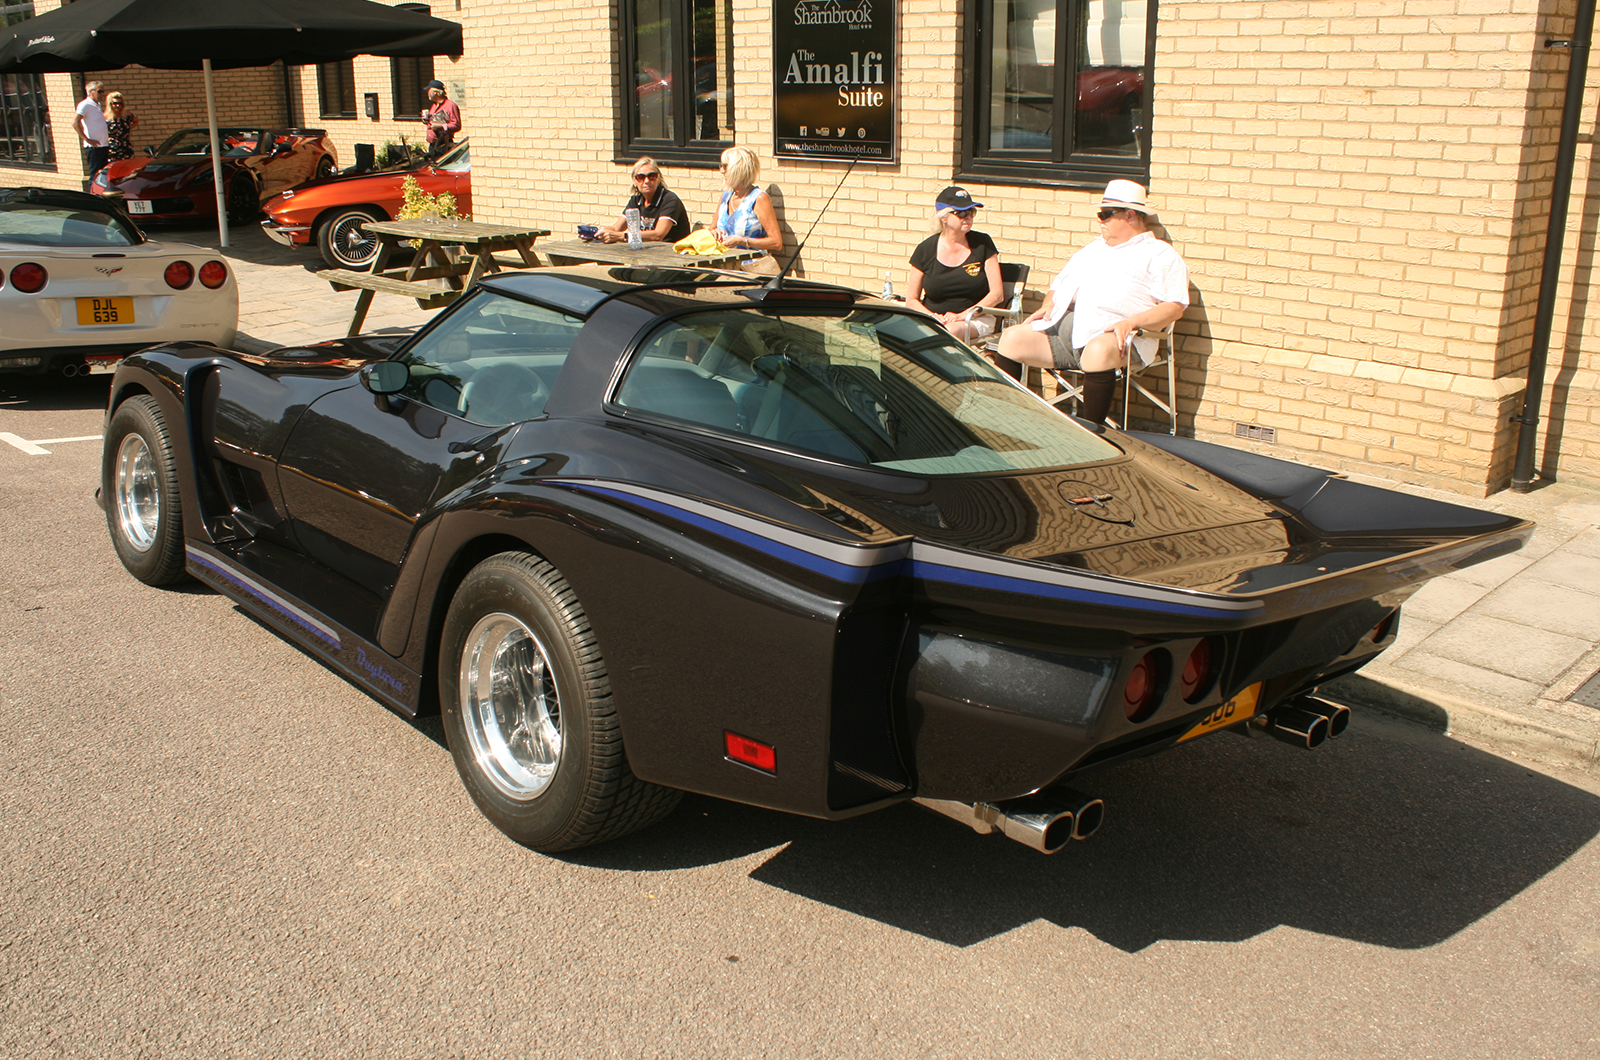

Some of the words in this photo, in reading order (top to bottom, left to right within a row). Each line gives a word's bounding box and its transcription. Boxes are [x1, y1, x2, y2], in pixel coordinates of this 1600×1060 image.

[794, 5, 872, 25] Sharnbrook
[797, 49, 815, 61] The
[783, 51, 884, 84] Amalfi
[838, 85, 884, 107] Suite
[784, 142, 882, 154] www.thesharnbrookhotel.com
[92, 299, 117, 311] DJL
[94, 311, 118, 323] 639
